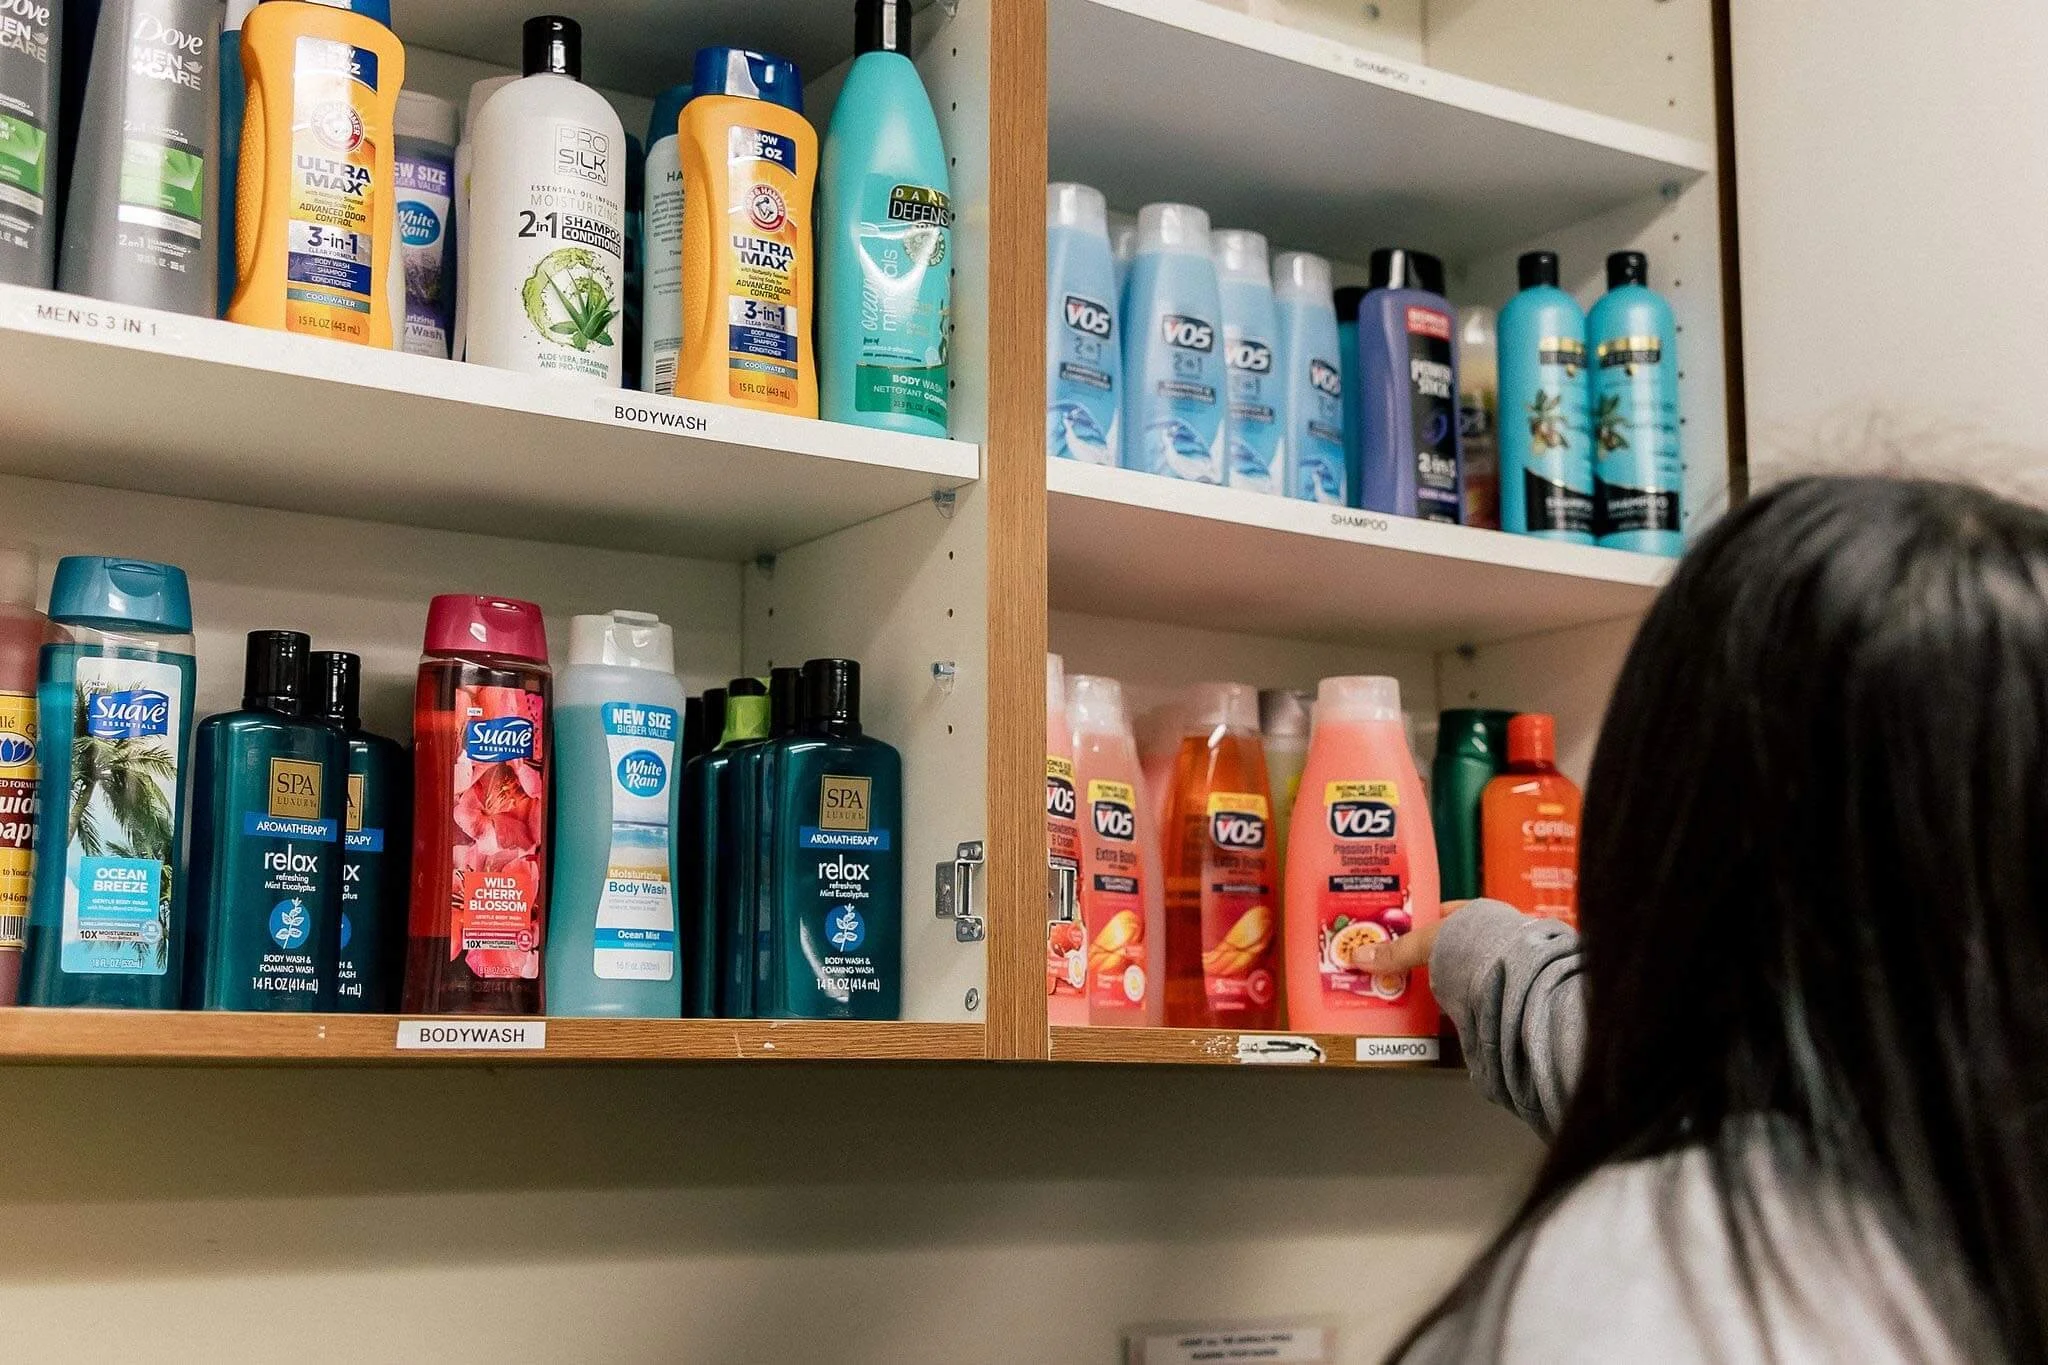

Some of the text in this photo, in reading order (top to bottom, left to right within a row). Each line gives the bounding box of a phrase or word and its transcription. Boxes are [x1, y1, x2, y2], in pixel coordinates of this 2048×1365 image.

[133, 13, 203, 55] Dove
[134, 47, 183, 70] MEN
[560, 127, 608, 154] PRO
[754, 133, 778, 146] NOW
[558, 147, 606, 175] SILK
[764, 146, 783, 160] OZ
[297, 154, 372, 184] ULTRA
[395, 161, 447, 186] EW SIZE
[558, 164, 607, 184] SALON
[305, 172, 364, 197] MAX
[530, 184, 577, 196] ESSENTIAL
[580, 190, 593, 200] OIL
[299, 202, 367, 223] ADVANCED ODOR
[530, 193, 618, 225] MOISTURIZING
[892, 200, 949, 227] DEFENS
[316, 213, 353, 228] CONTROL
[307, 225, 358, 255] 3-in-1
[733, 235, 795, 260] ULTRA
[314, 257, 351, 270] BODY WASH
[741, 251, 789, 273] MAX
[317, 266, 347, 278] SHAMPOO
[311, 275, 352, 289] CONDITIONER
[736, 279, 792, 297] ADVANCED ODOR
[750, 288, 781, 301] CONTROL
[880, 249, 900, 332] minals
[306, 292, 356, 308] COOL WATER
[37, 304, 158, 337] MEN'S 3 IN 1
[744, 299, 785, 326] 3-in-1
[298, 315, 308, 326] 15
[309, 316, 318, 328] FL
[319, 318, 331, 329] OZ
[412, 325, 443, 341] Wash
[537, 352, 557, 361] ALOE
[540, 360, 557, 369] AND
[744, 361, 786, 375] COOL WATER
[739, 382, 748, 392] 15
[892, 374, 920, 387] BODY
[873, 384, 922, 398] NETTOYANT
[614, 405, 707, 432] BODYWASH
[1330, 512, 1389, 533] SHAMPOO
[91, 696, 166, 723] Suave
[102, 720, 157, 730] ESSENTIALS
[612, 708, 672, 730] NEW SIZE
[469, 722, 532, 748] Suave
[617, 724, 669, 739] BIGGER VALUE
[479, 745, 525, 755] ESSENTIALS
[625, 758, 663, 777] White
[276, 772, 315, 797] SPA
[625, 773, 658, 789] Rain
[0, 788, 34, 815] uid
[826, 788, 864, 810] SPA
[256, 820, 328, 837] AROMATHERAPY
[1095, 809, 1134, 836] VO5
[1333, 808, 1393, 835] VO5
[1216, 819, 1264, 844] VO5
[810, 833, 880, 847] AROMATHERAPY
[264, 843, 319, 874] relax
[96, 867, 148, 881] OCEAN
[609, 868, 662, 882] Moisturizing
[818, 854, 870, 881] relax
[264, 880, 317, 893] Mint Eucalyptus
[275, 873, 310, 884] refreshing
[484, 877, 517, 889] WILD
[829, 881, 862, 892] refreshing
[93, 880, 149, 894] BREEZE
[474, 888, 523, 901] CHERRY
[609, 881, 668, 896] Body Wash
[819, 888, 870, 900] Mint Eucalyptus
[469, 899, 528, 913] BLOSSOM
[80, 930, 98, 940] 10X
[98, 930, 140, 938] MOISTURIZERS
[617, 930, 661, 940] Ocean Mist
[465, 940, 482, 949] 10X
[263, 954, 313, 965] BODY WASH &
[824, 956, 871, 965] BODY WASH &
[259, 963, 315, 975] FOAMING WASH
[822, 966, 875, 975] FOAMING WASH
[252, 977, 320, 995] 14 FL OZ (414 mL)
[816, 978, 826, 991] 14
[837, 978, 850, 991] OZ
[850, 977, 867, 993] (414
[867, 978, 880, 993] mL)
[420, 1027, 525, 1043] BODYWASH
[1368, 1043, 1428, 1057] SHAMPOO
